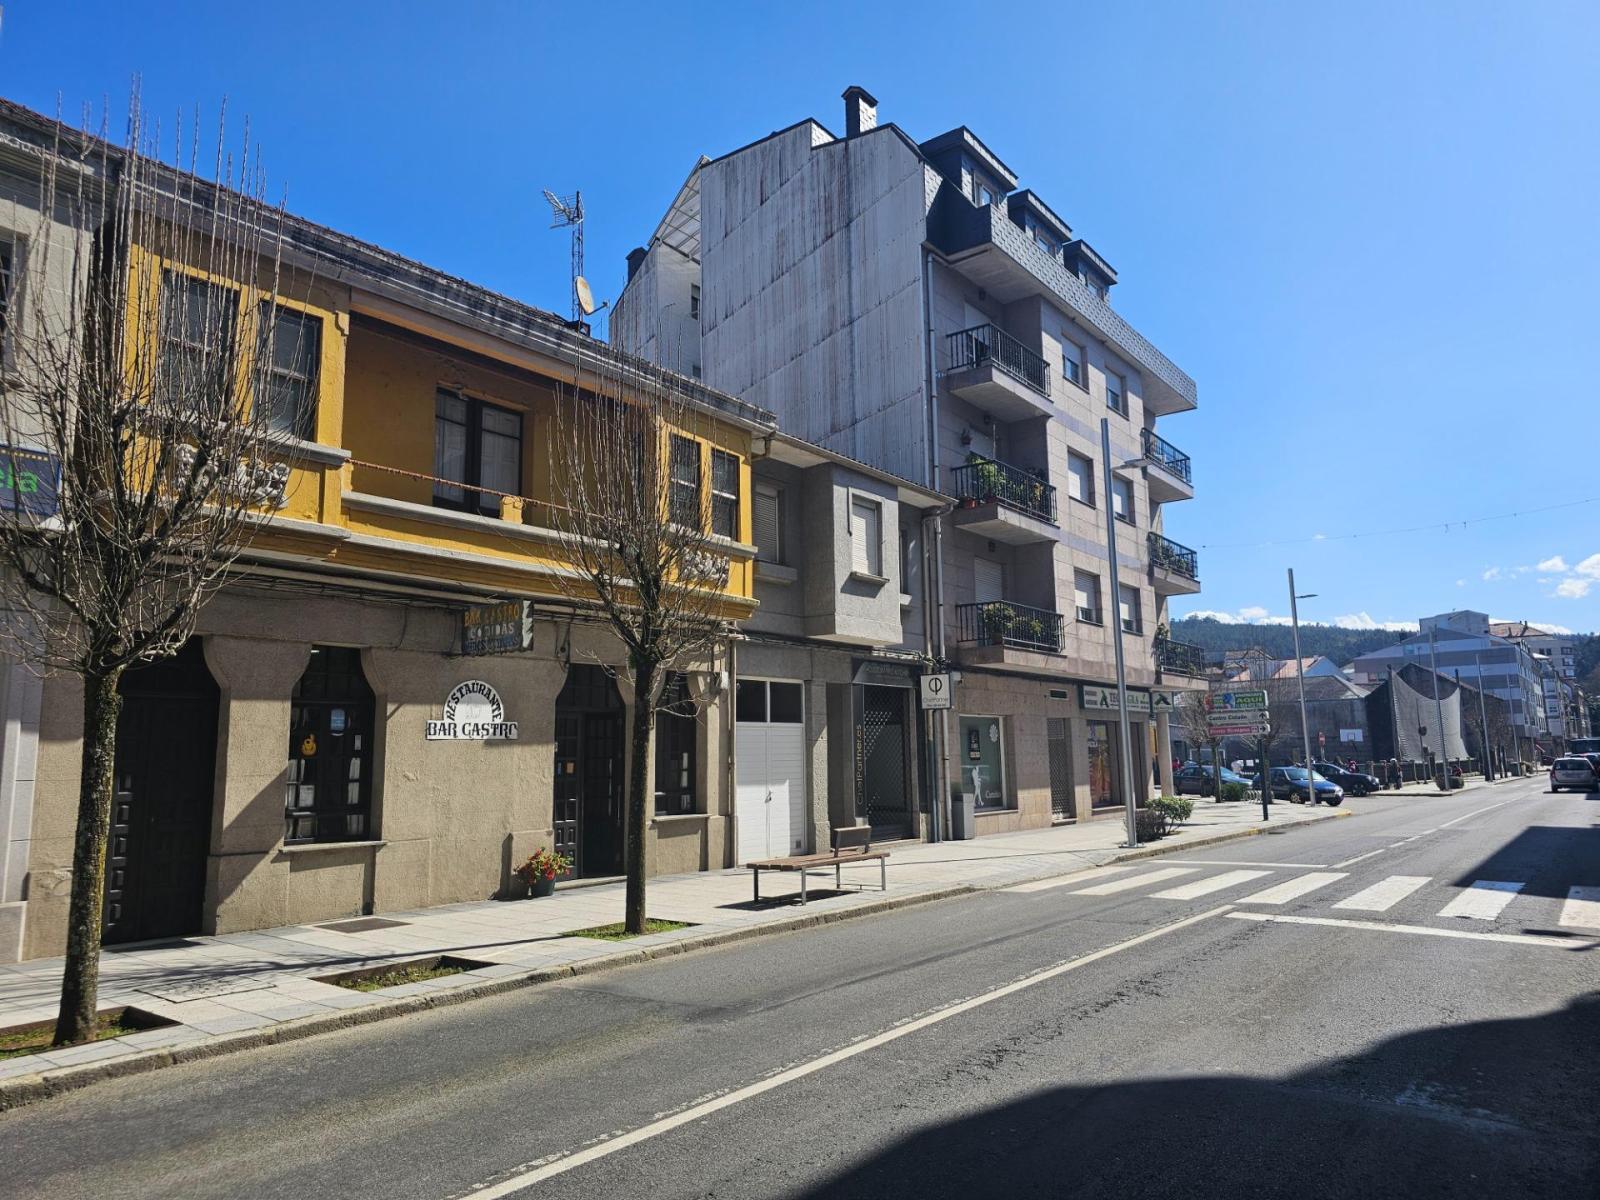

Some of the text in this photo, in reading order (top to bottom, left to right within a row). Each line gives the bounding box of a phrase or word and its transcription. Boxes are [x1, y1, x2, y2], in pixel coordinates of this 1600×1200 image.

[0, 463, 38, 493] la
[446, 682, 502, 721] RESTAURANTE
[427, 722, 458, 739] BAR
